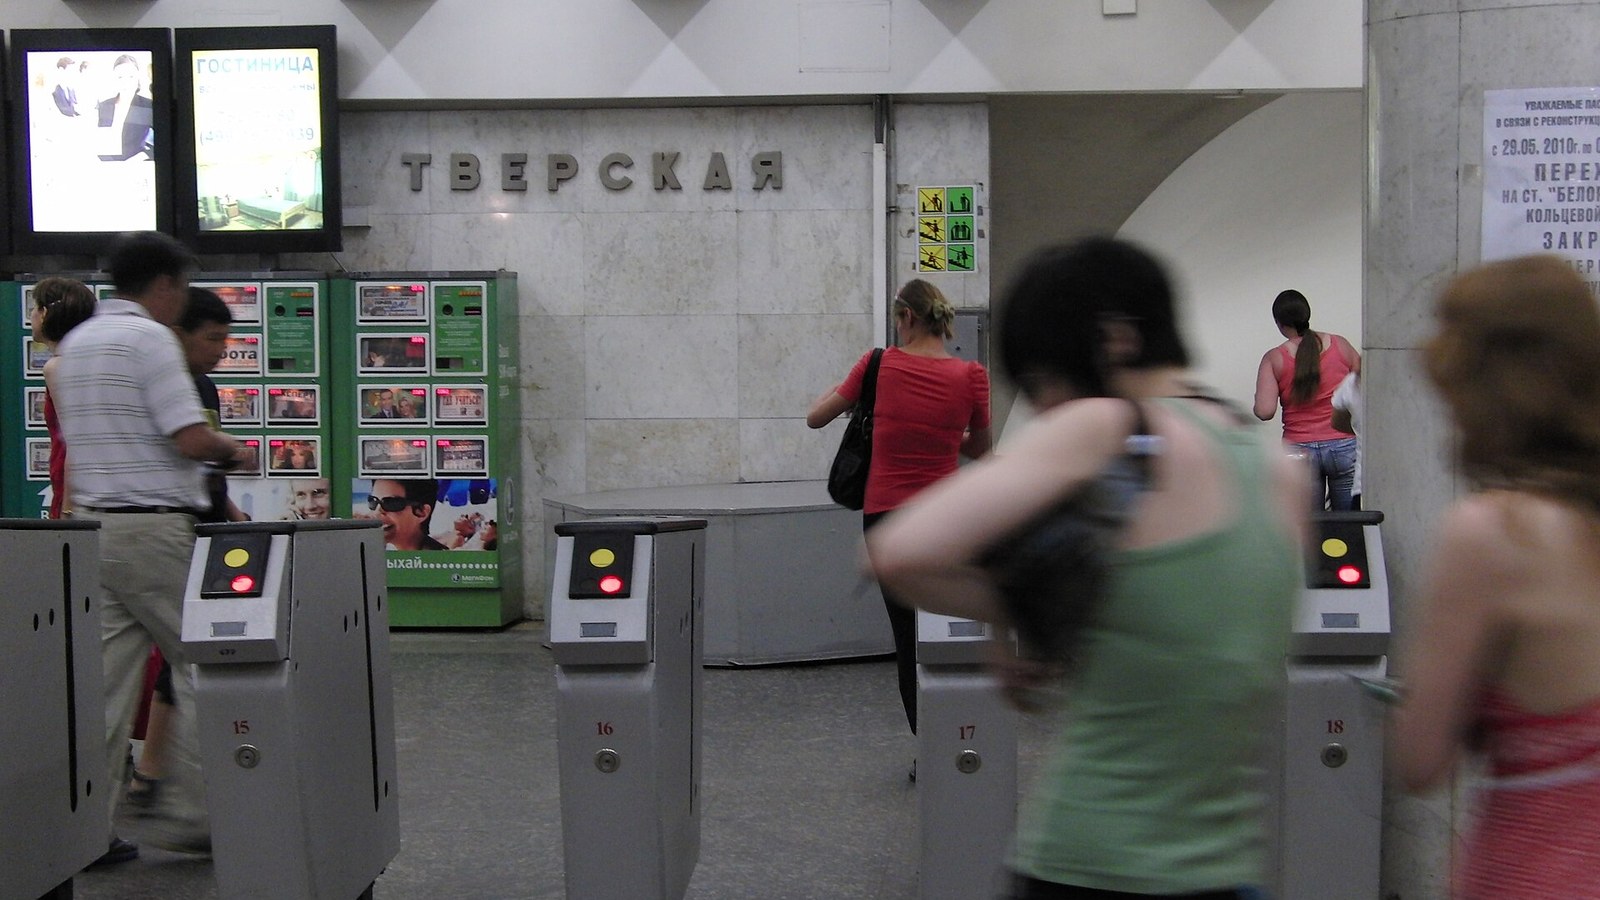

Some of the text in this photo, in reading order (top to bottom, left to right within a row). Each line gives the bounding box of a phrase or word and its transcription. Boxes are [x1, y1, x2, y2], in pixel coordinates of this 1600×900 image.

[196, 56, 314, 74] ГОСТИНИЦА
[1525, 100, 1583, 111] УВАЖАЕМЫЕ
[1496, 118, 1502, 128] В
[1504, 117, 1531, 127] СВЯЗИ
[1533, 117, 1540, 126] С
[1502, 138, 1540, 156] 29.05.
[401, 151, 783, 192] ТВЕРСКАЯ
[1502, 189, 1518, 204] НА
[1522, 189, 1543, 203] СТ.
[1526, 206, 1600, 225] КОЛЬЦЕВОЙ
[232, 720, 250, 735] 15
[597, 721, 613, 736] 16
[960, 725, 976, 740] 17
[1326, 719, 1344, 734] 18
